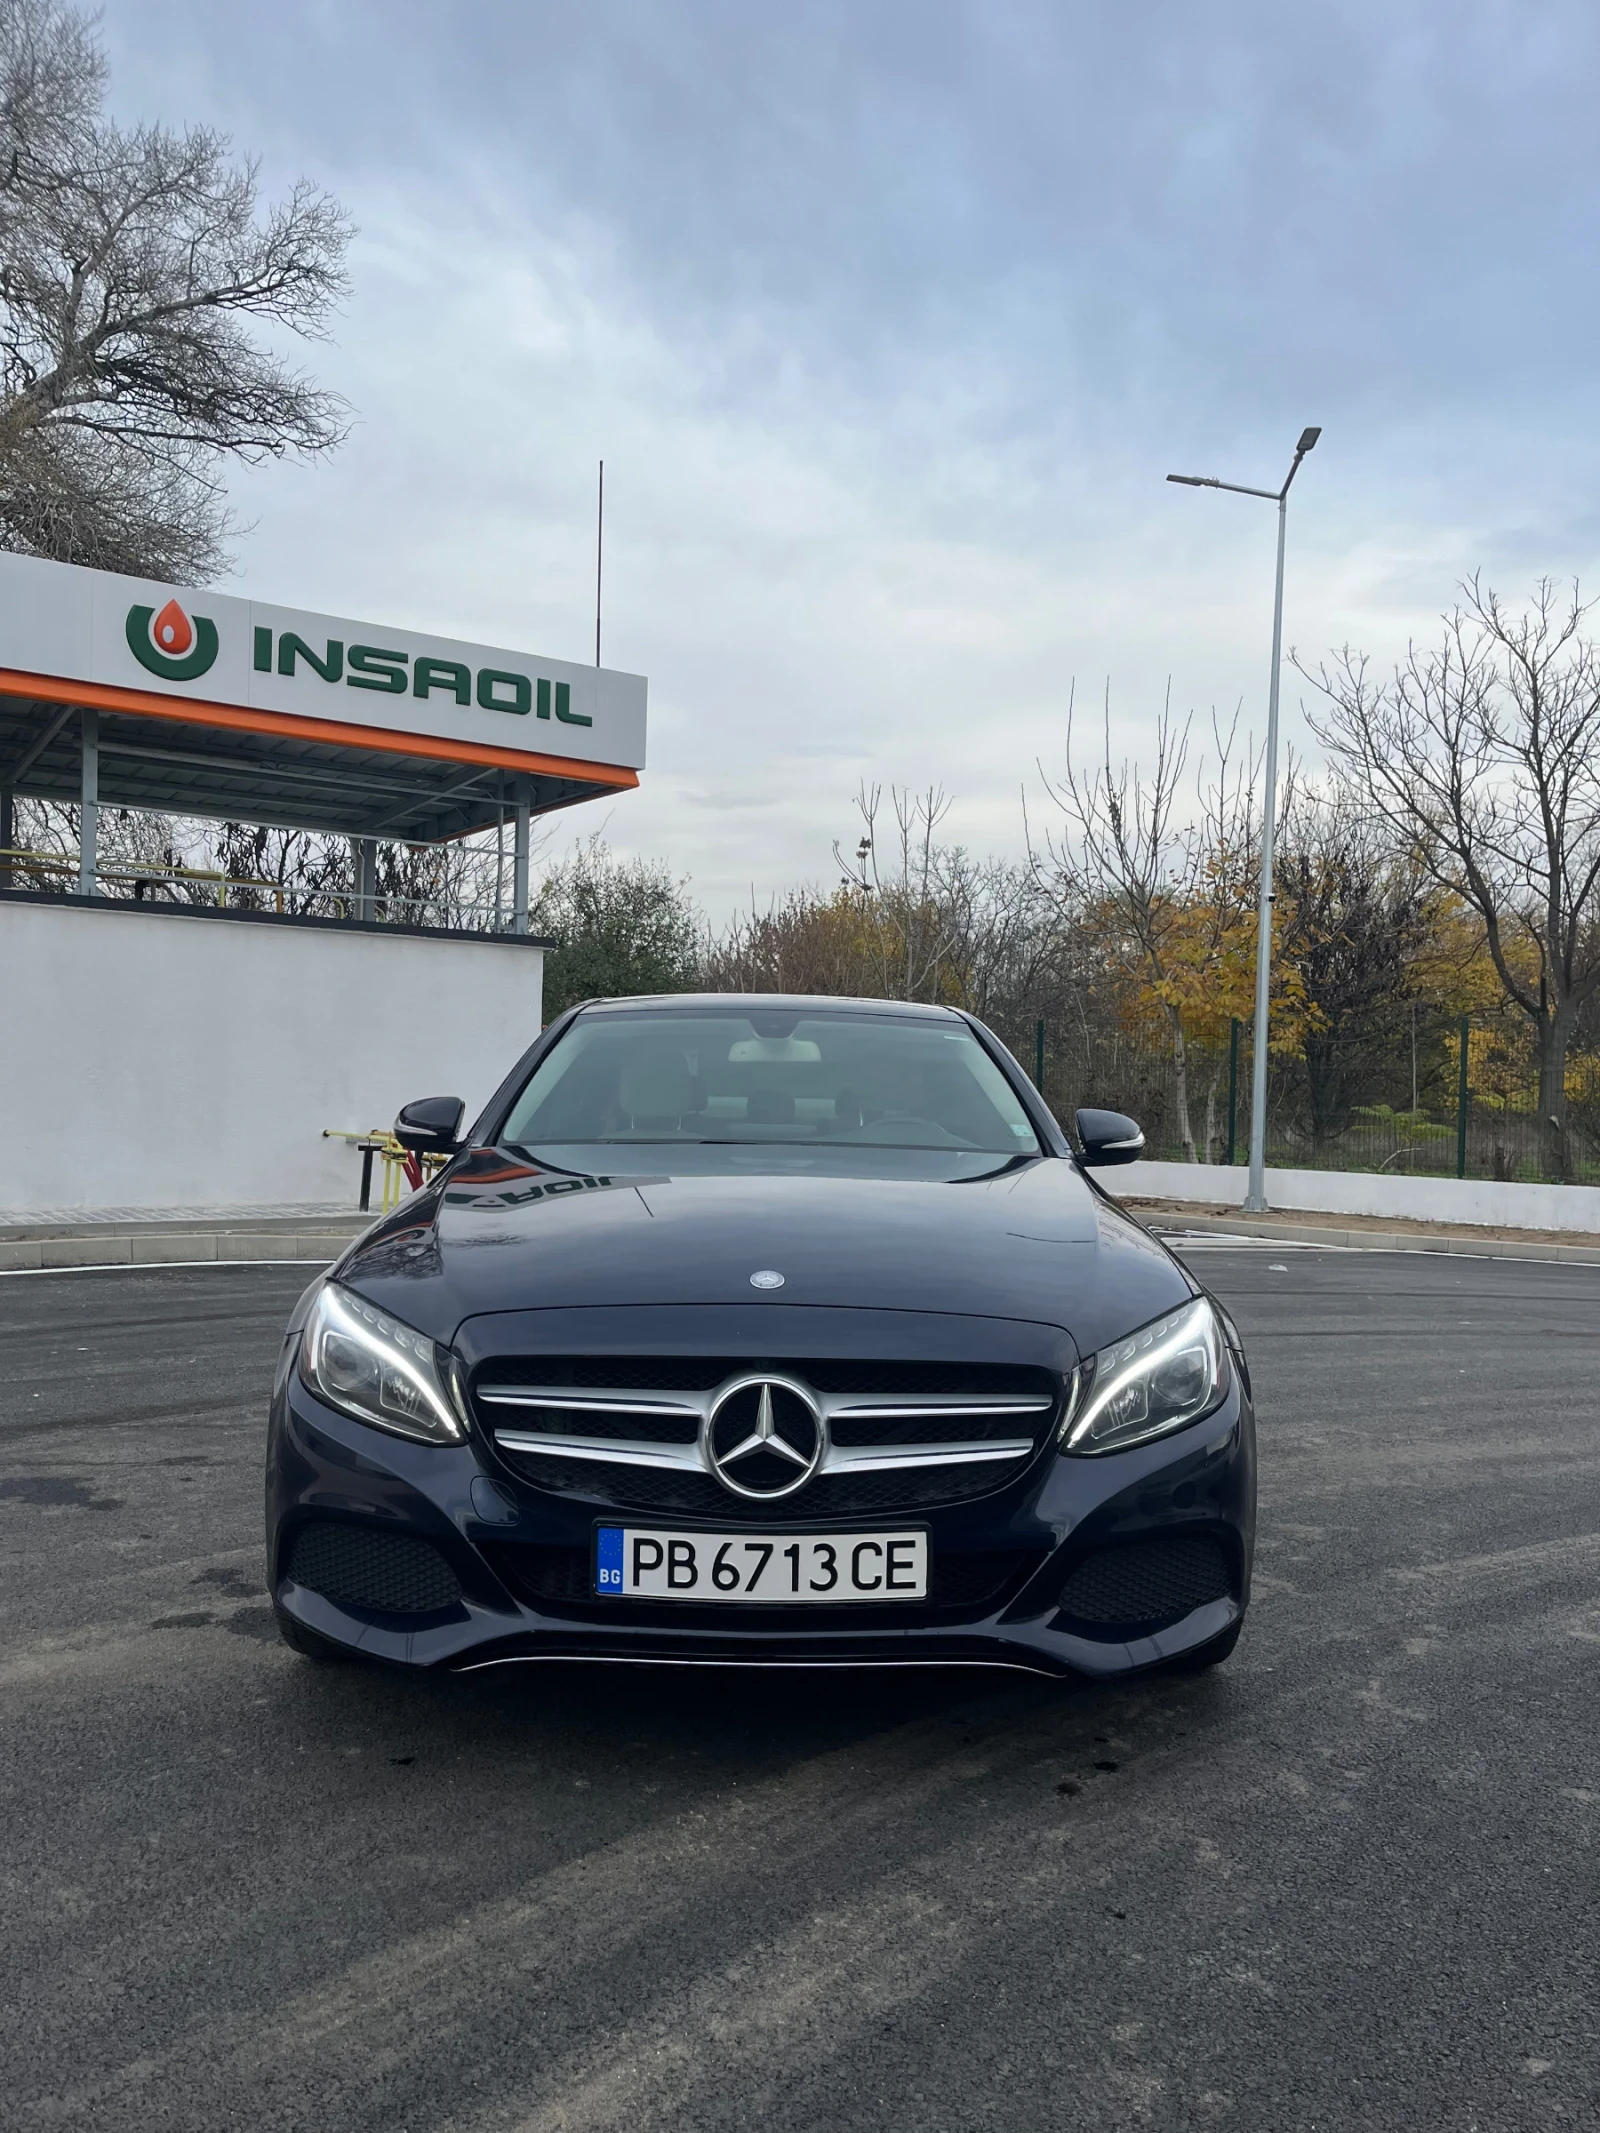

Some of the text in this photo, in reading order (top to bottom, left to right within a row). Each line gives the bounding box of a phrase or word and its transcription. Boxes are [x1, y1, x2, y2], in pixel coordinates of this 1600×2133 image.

[254, 625, 593, 728] INSAOIL
[599, 1568, 621, 1584] BG
[632, 1537, 917, 1592] PB 6713 CE
